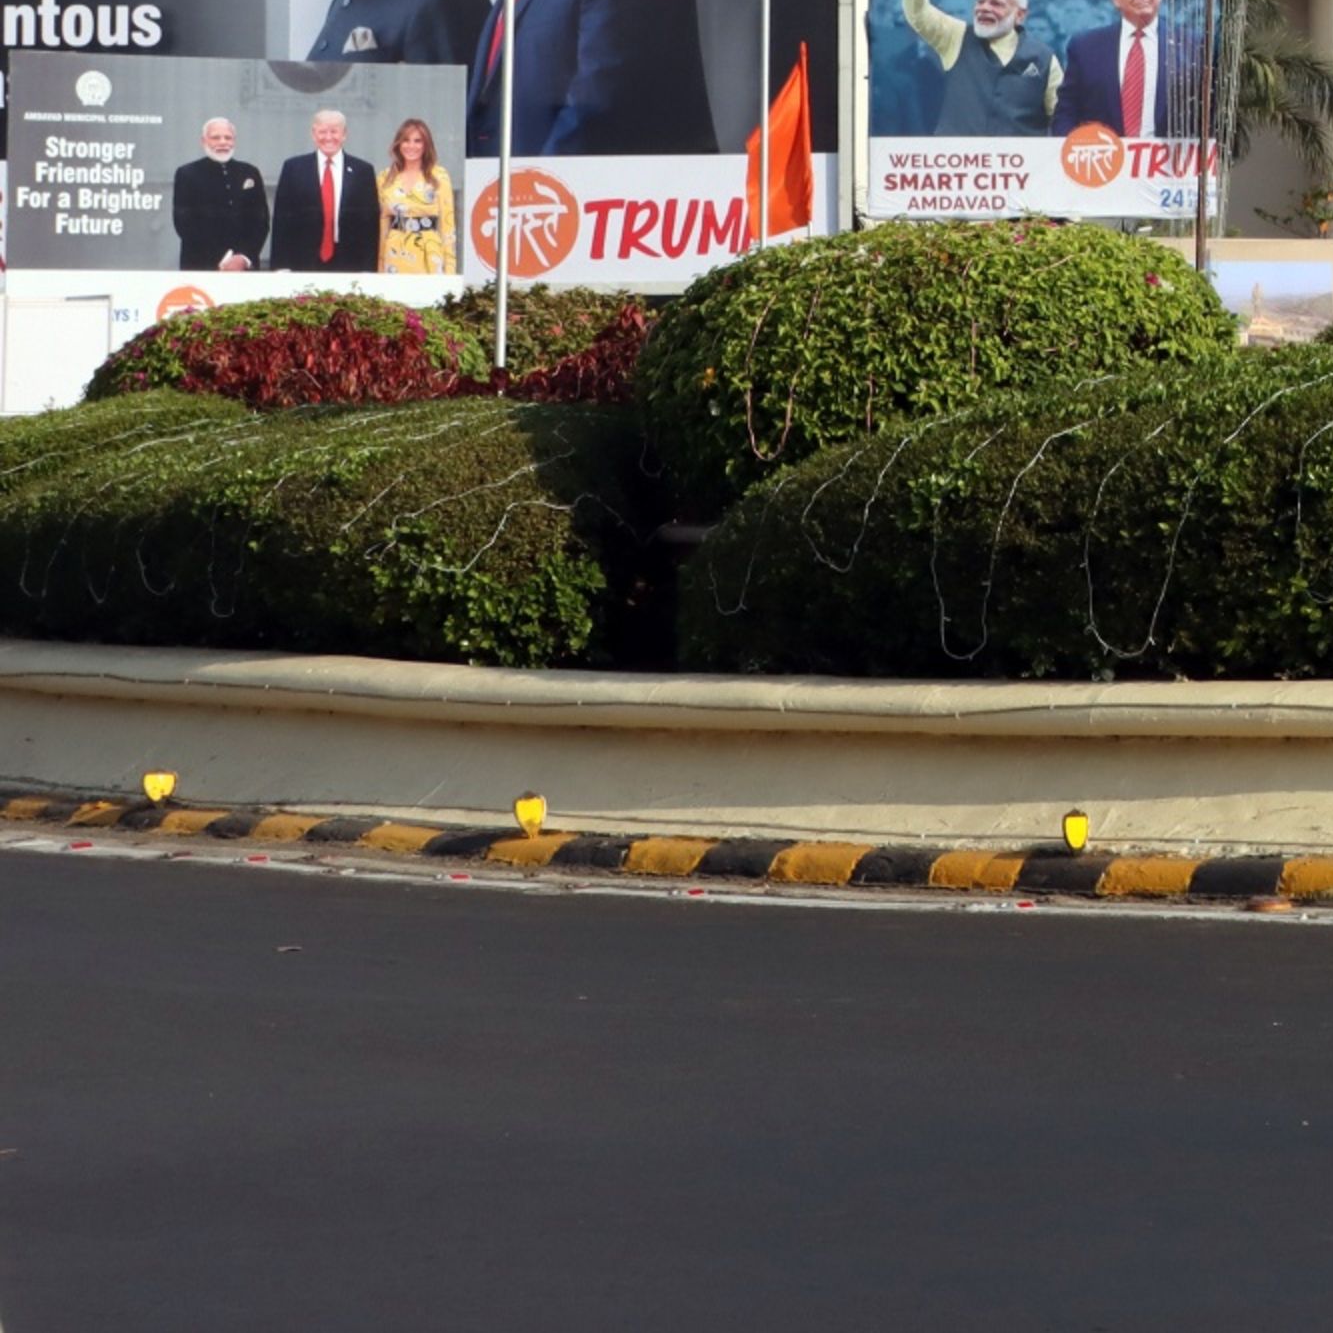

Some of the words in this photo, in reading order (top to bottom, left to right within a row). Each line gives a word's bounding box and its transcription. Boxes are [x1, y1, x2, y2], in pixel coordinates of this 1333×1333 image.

[45, 136, 136, 163] Stronger
[889, 153, 992, 168] WELCOME
[997, 154, 1025, 168] TO
[35, 162, 145, 189] Friendship
[884, 173, 968, 191] SMART
[974, 173, 1030, 191] CITY
[16, 187, 52, 209] For
[57, 191, 72, 209] a
[78, 188, 163, 214] Brighter
[907, 195, 1006, 211] AMDAVAD
[1160, 188, 1185, 208] 24
[55, 214, 124, 236] Future
